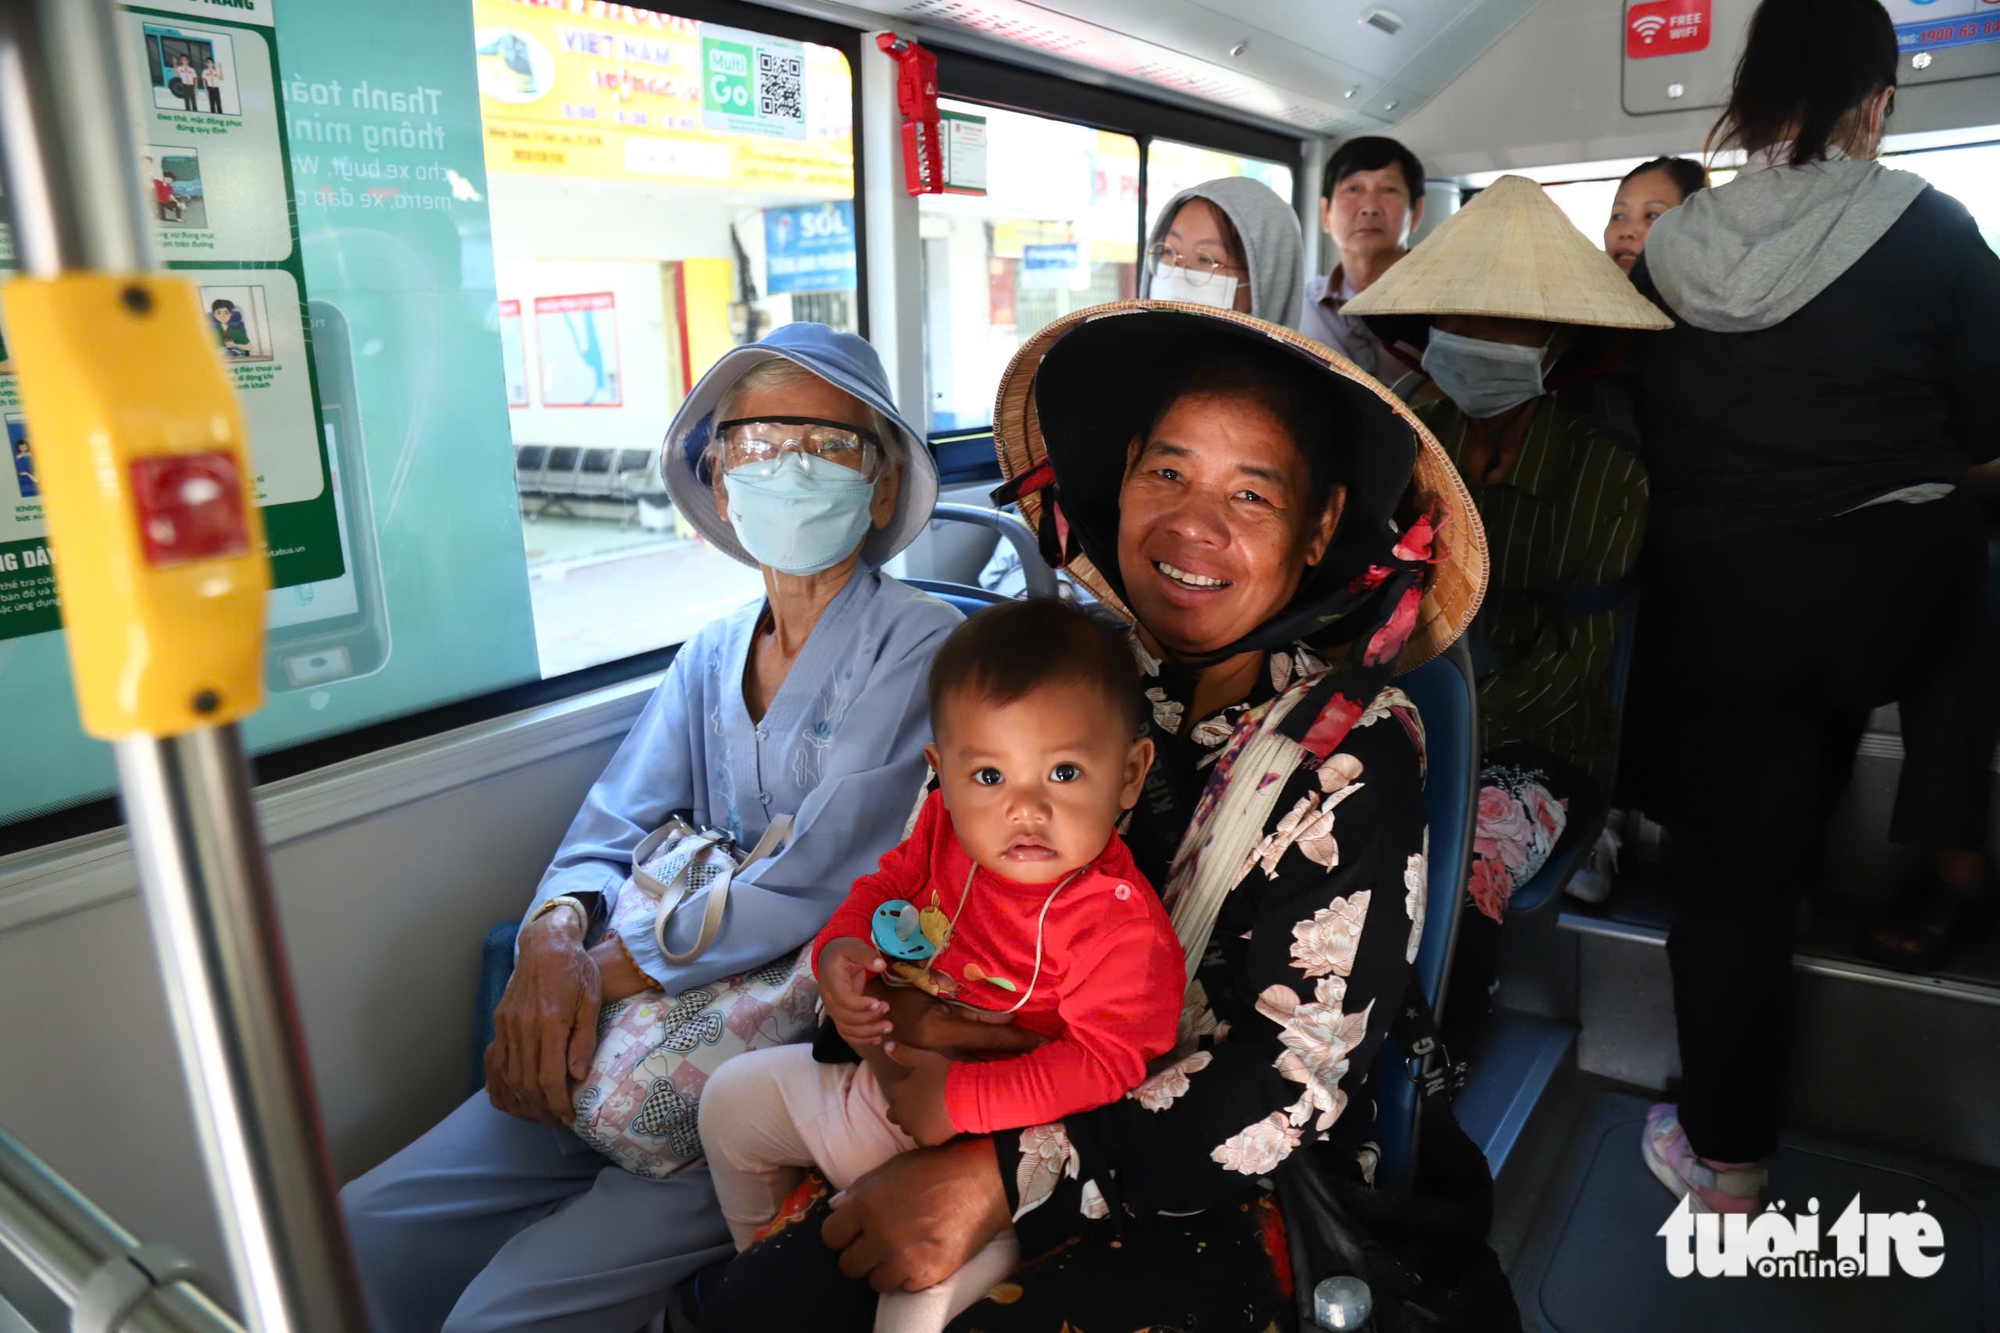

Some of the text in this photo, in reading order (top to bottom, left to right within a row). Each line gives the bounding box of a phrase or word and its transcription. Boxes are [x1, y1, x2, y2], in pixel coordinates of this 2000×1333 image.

[203, 0, 254, 10] ANG
[1669, 12, 1702, 27] FREE
[1669, 26, 1698, 39] WIFI
[1920, 26, 1954, 43] 1900
[1960, 23, 1977, 38] 63
[712, 53, 745, 72] Multi
[710, 74, 749, 107] Go
[20, 578, 36, 588] tra
[1138, 720, 1174, 814] KIPLG
